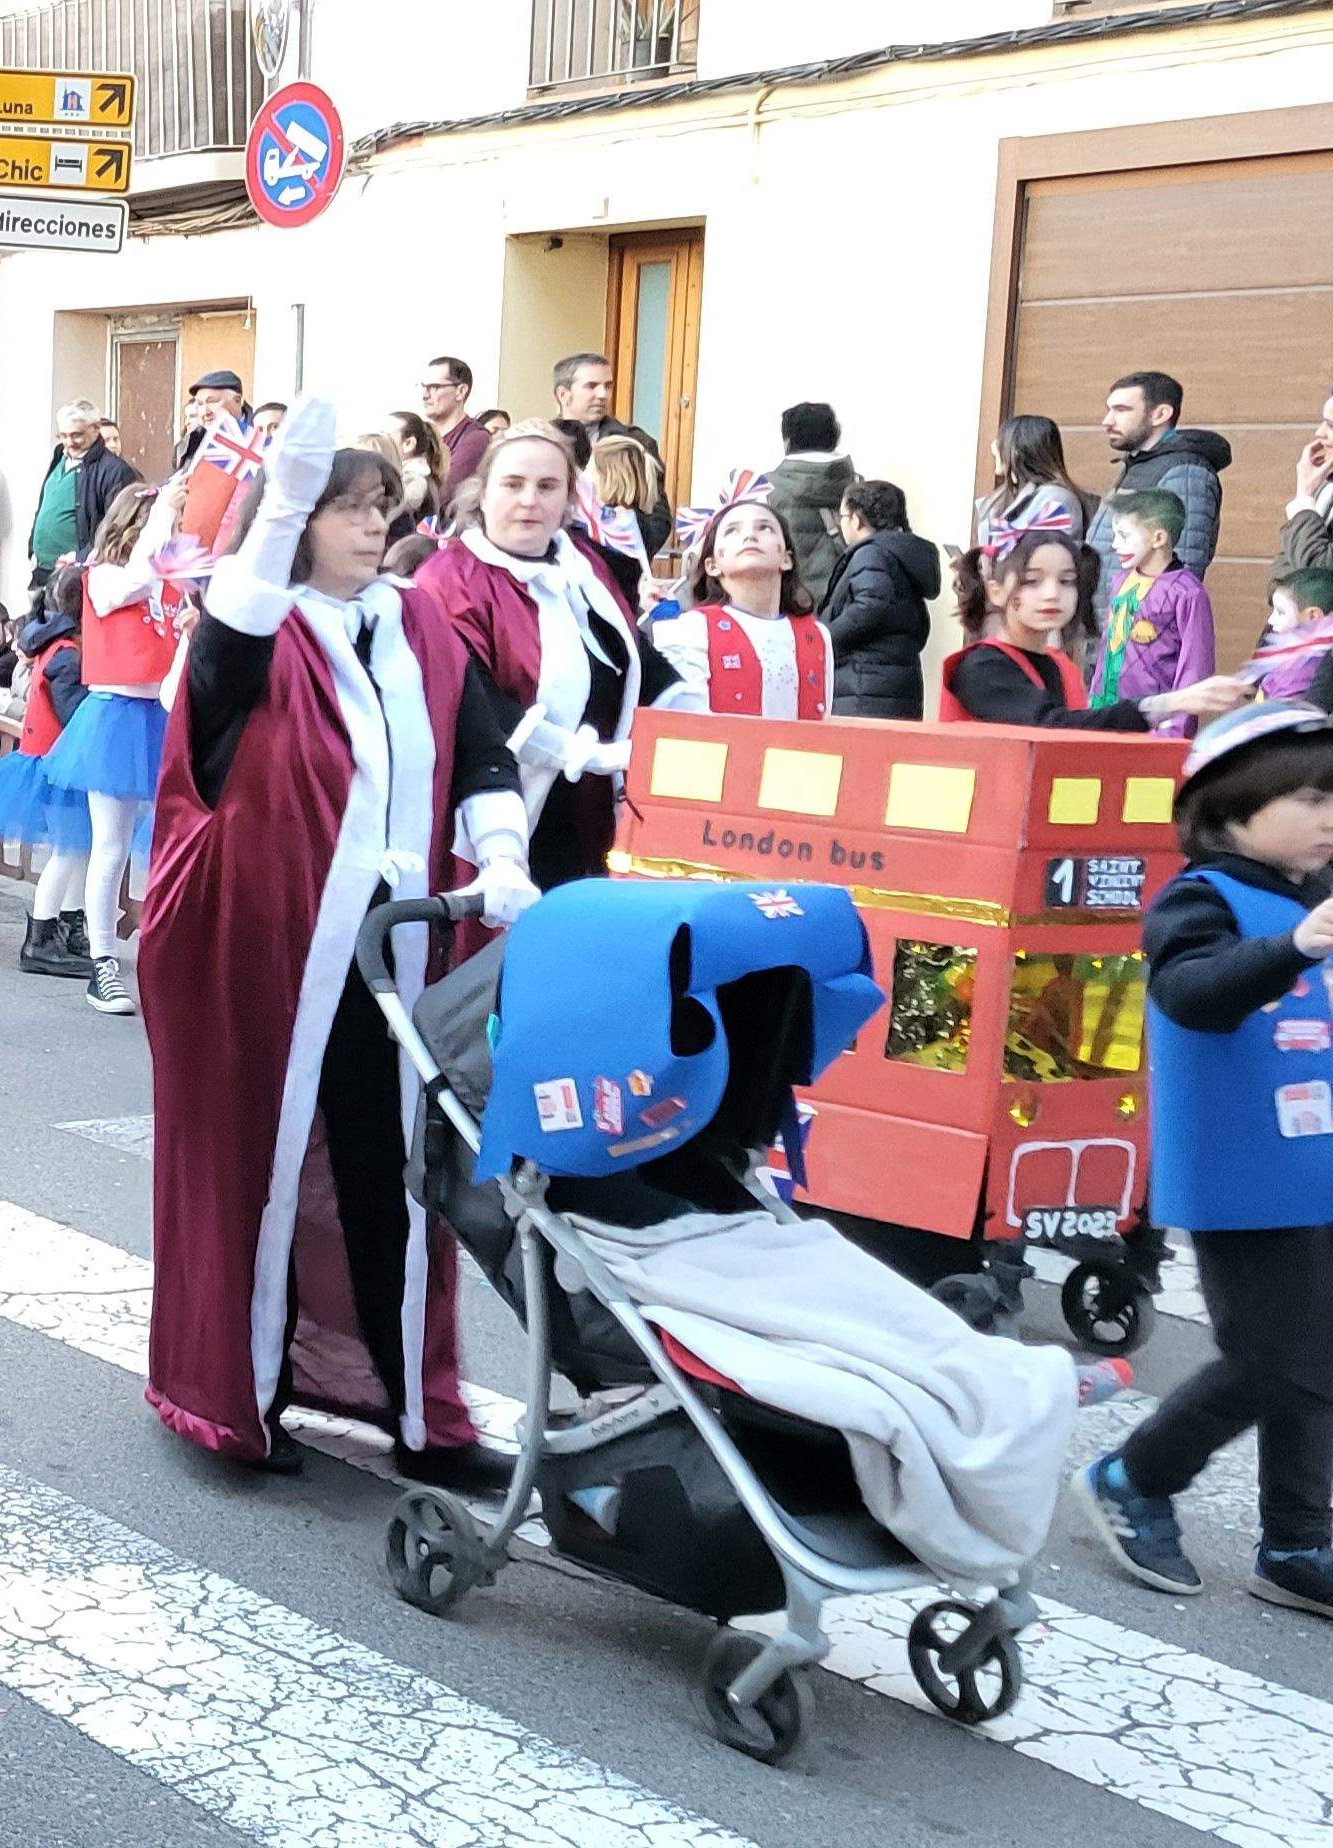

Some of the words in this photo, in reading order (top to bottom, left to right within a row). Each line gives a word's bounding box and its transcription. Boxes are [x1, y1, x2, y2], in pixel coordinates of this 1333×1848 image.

[702, 820, 813, 862] London
[830, 840, 884, 871] bus
[1052, 859, 1074, 903] 1
